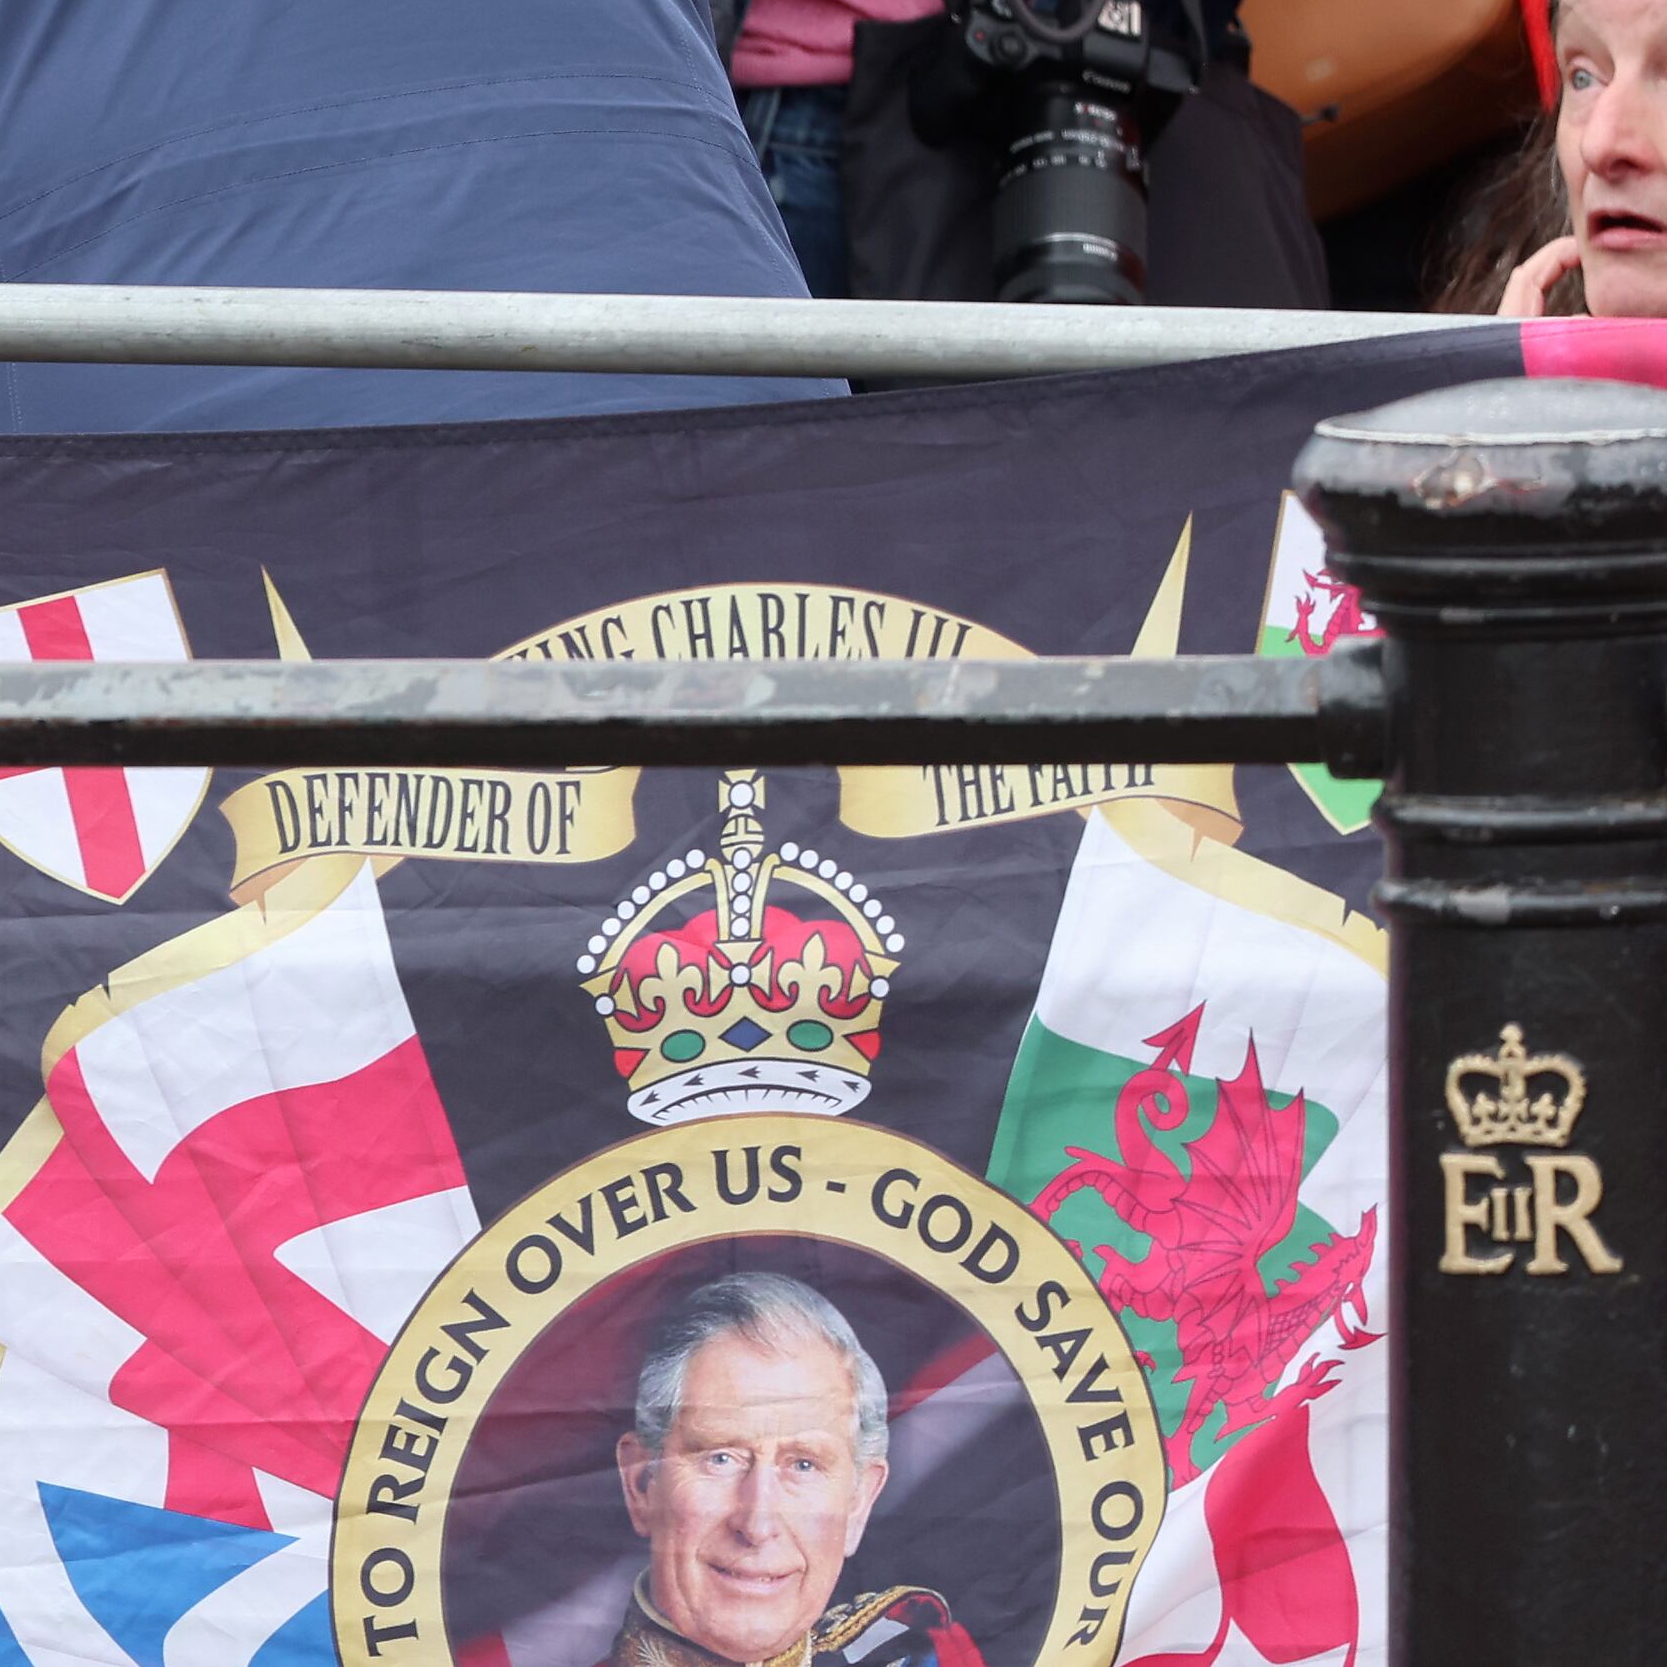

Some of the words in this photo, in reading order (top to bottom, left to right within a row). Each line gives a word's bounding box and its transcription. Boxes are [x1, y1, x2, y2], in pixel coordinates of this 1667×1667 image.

[652, 592, 886, 662] CHARLES
[265, 771, 512, 855] DEFENDER
[527, 780, 581, 856] OF
[923, 764, 1015, 827] THE
[505, 1162, 695, 1294] OVER
[711, 1145, 803, 1205] US
[871, 1168, 1021, 1286] GOD
[367, 1289, 511, 1526] REIGN
[1015, 1279, 1135, 1462] SAVE
[362, 1547, 418, 1658] TO
[1065, 1480, 1145, 1650] OUR
